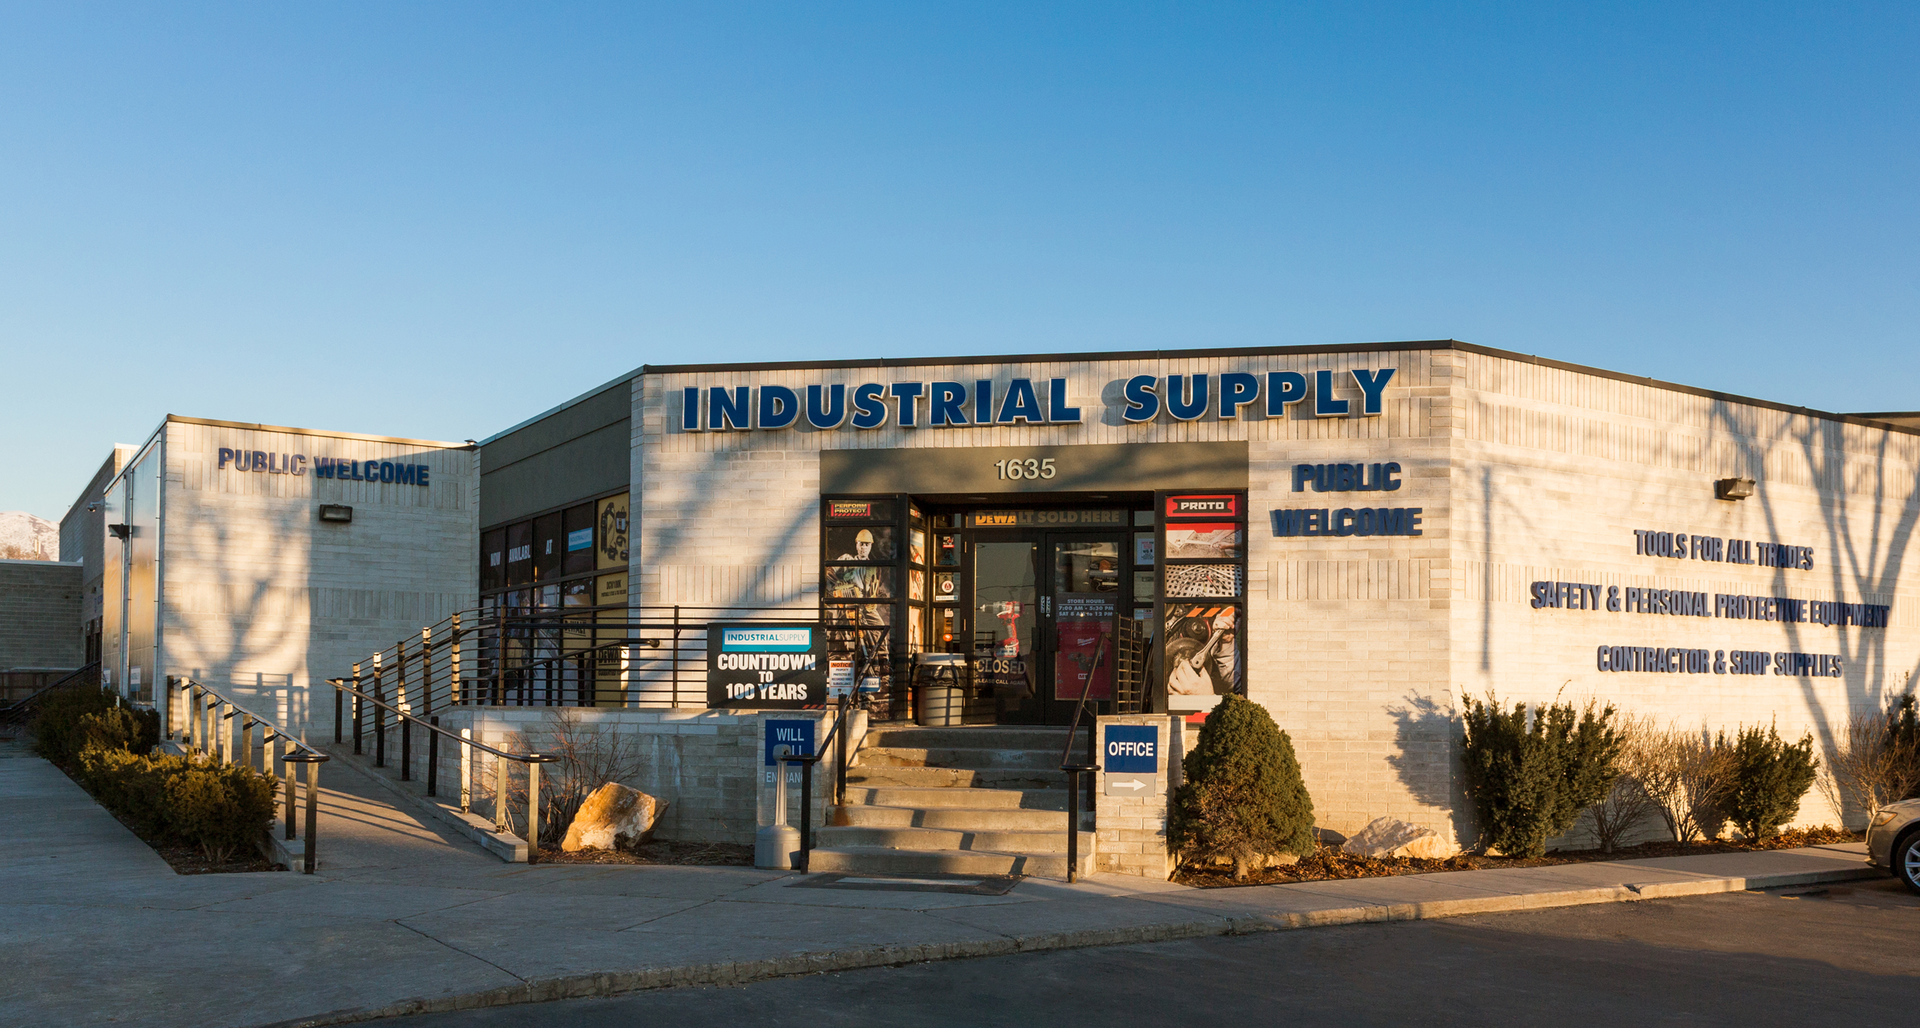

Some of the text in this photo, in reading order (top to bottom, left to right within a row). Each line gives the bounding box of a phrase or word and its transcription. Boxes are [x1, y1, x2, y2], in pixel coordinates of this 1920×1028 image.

[683, 368, 1397, 431] INDUSTRIAL SUPPLY
[218, 447, 430, 487] PUBLIC WELCOME
[995, 458, 1056, 480] 1635
[1294, 462, 1402, 493] PUBLIC
[1180, 501, 1225, 510] PROTO
[976, 511, 1119, 524] DEWALT SOLD HERE
[1273, 507, 1423, 538] WELCOME
[490, 551, 501, 567] NOW
[545, 539, 553, 555] AT
[1633, 529, 1814, 570] TOOLS FOR ALL TRADES
[1530, 581, 1890, 628] SAFETY & PERSONAL PROTECTIVE EQUIPMENT
[599, 647, 621, 664] DEWA
[717, 653, 816, 671] COUNTDOWN
[1597, 645, 1843, 678] CONTRACTOR & SHOP SUPPLIES
[976, 658, 1026, 675] CLOSED
[758, 671, 774, 683] TO
[726, 683, 808, 700] 100 YEARS
[776, 727, 805, 742] WILL
[1108, 741, 1154, 757] OFFICE
[766, 771, 813, 784] ENRAN
